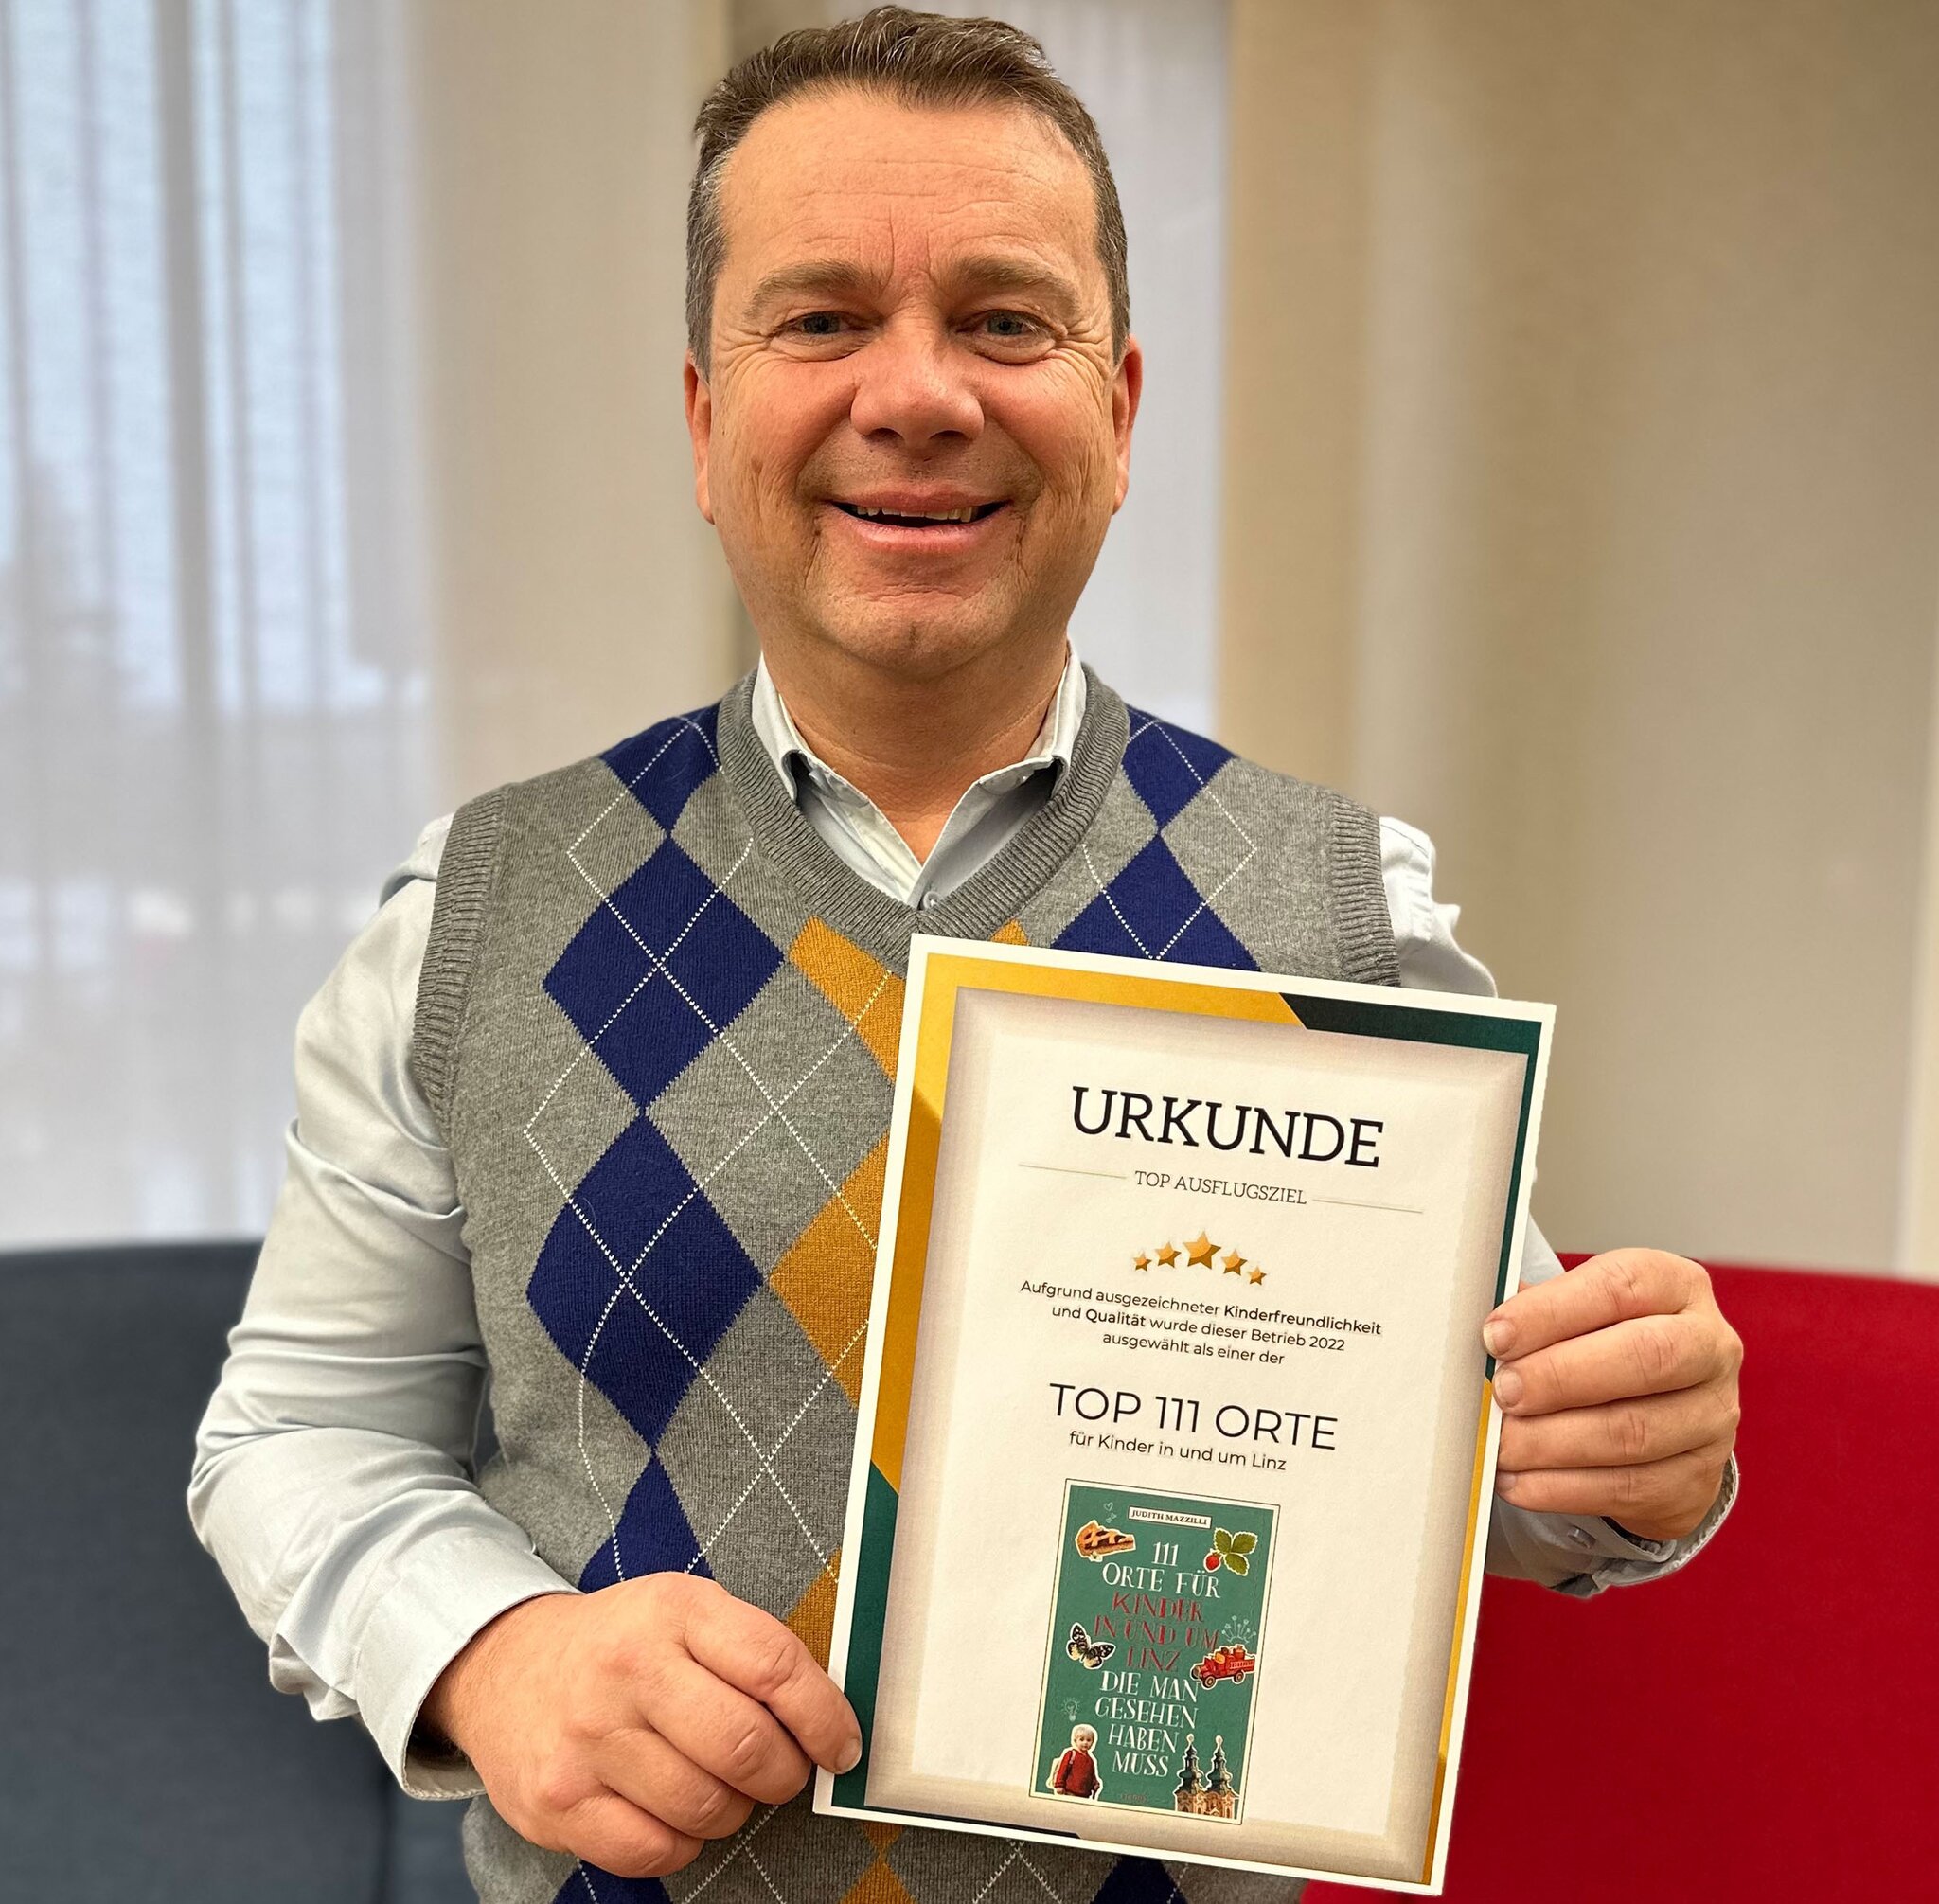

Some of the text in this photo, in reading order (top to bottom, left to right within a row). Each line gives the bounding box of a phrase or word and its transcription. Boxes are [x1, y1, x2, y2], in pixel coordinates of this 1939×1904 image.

[1073, 1086, 1384, 1167] URKUNDE
[1134, 1170, 1307, 1205] TOP AUSFLUGSZIEL
[1021, 1280, 1382, 1336] Aufgrund ausgezeichneter Kinderfreundlichkeit
[1052, 1304, 1345, 1351] und Qualität wurde dieser Betrieb 2022
[1103, 1333, 1285, 1365] ausgewählt als einer der
[1049, 1383, 1338, 1450] TOP 111 ORTE
[1069, 1431, 1287, 1471] für Kinder in und um Linz
[1131, 1510, 1207, 1524] JUDITH MAZZILLI
[1151, 1541, 1180, 1567] 111
[1102, 1562, 1221, 1598] ORTE FÜR
[1112, 1592, 1204, 1624] KINDER
[1094, 1615, 1219, 1650] IN UND UM
[1127, 1647, 1181, 1672] LINZ
[1099, 1671, 1200, 1702] DIE MAN
[1094, 1697, 1198, 1729] GESEHEN
[1108, 1724, 1180, 1753] HABEN
[1112, 1751, 1169, 1777] MUSS
